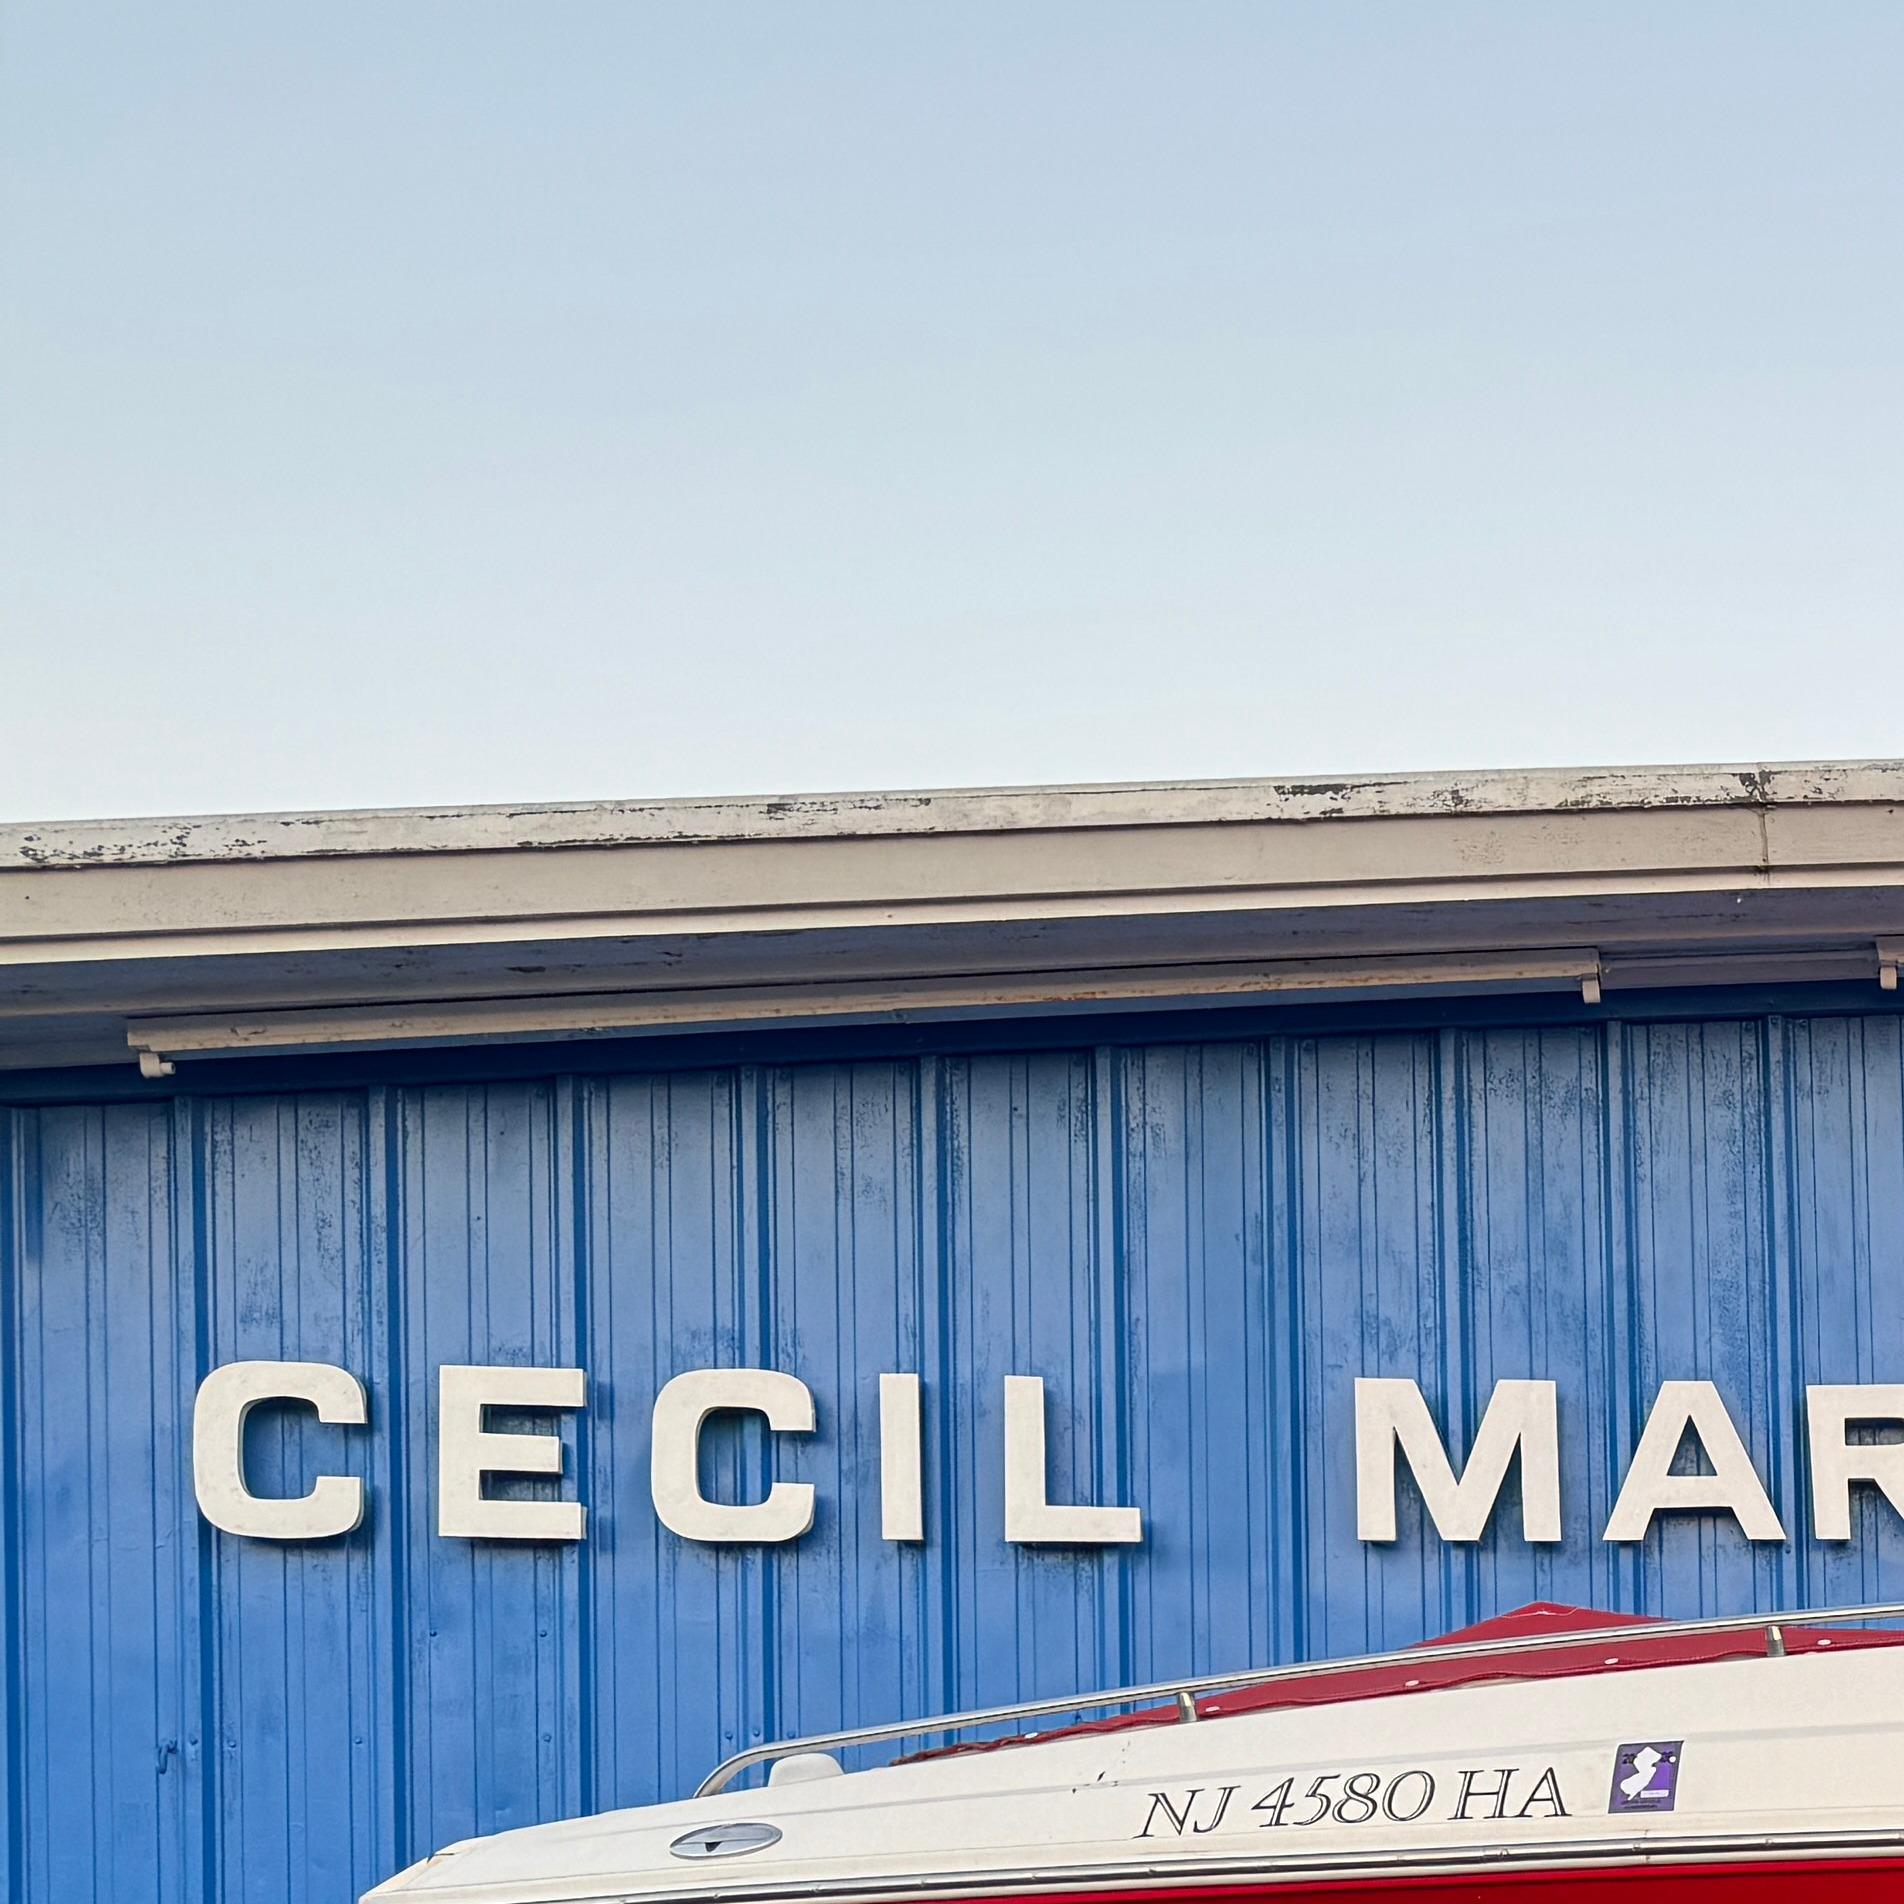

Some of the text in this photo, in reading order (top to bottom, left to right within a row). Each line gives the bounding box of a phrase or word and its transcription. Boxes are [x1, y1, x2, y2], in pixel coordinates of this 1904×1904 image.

[193, 1361, 1142, 1544] CECIL
[1133, 1767, 1572, 1838] NJ 4580 HA
